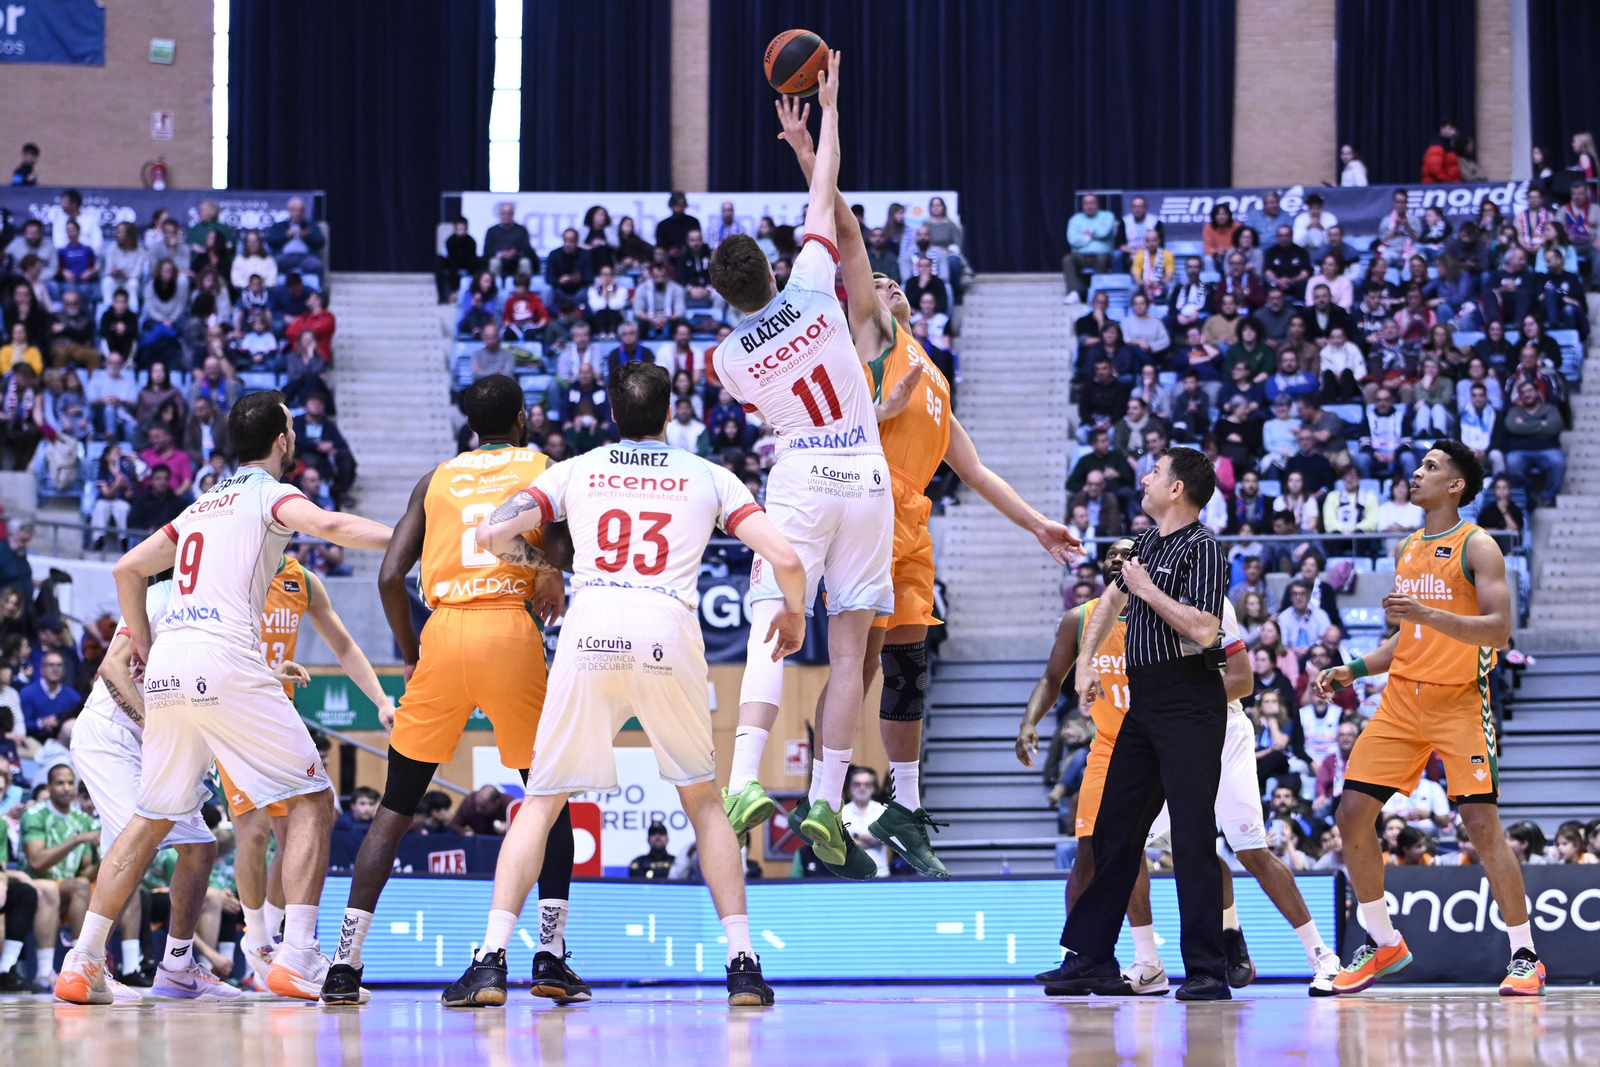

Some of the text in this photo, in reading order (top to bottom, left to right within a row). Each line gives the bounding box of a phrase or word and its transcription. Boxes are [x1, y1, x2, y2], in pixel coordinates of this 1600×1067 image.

[0, 4, 26, 35] r
[763, 314, 829, 370] cenor
[759, 326, 837, 388] electrodomésticos
[791, 363, 844, 428] 11
[925, 385, 943, 428] 52
[513, 450, 536, 462] III
[609, 448, 669, 467] SUÁREZ
[810, 465, 861, 481] A Coruña
[607, 475, 690, 492] cenor
[807, 478, 865, 492] UNHA PROVINCIA
[808, 485, 862, 499] POR DESCUBRIR
[190, 492, 240, 514] cenor
[588, 490, 689, 502] electrodomésticos
[595, 508, 672, 576] 93
[178, 531, 205, 596] 9
[450, 577, 528, 598] MEDAC
[1395, 573, 1453, 594] Sevilla.
[260, 608, 300, 628] villa
[576, 636, 632, 650] A Coruña
[259, 641, 286, 669] 13
[592, 653, 636, 664] PROVINCIA
[588, 662, 634, 671] DESCUBRIR
[147, 676, 181, 691] Coruña
